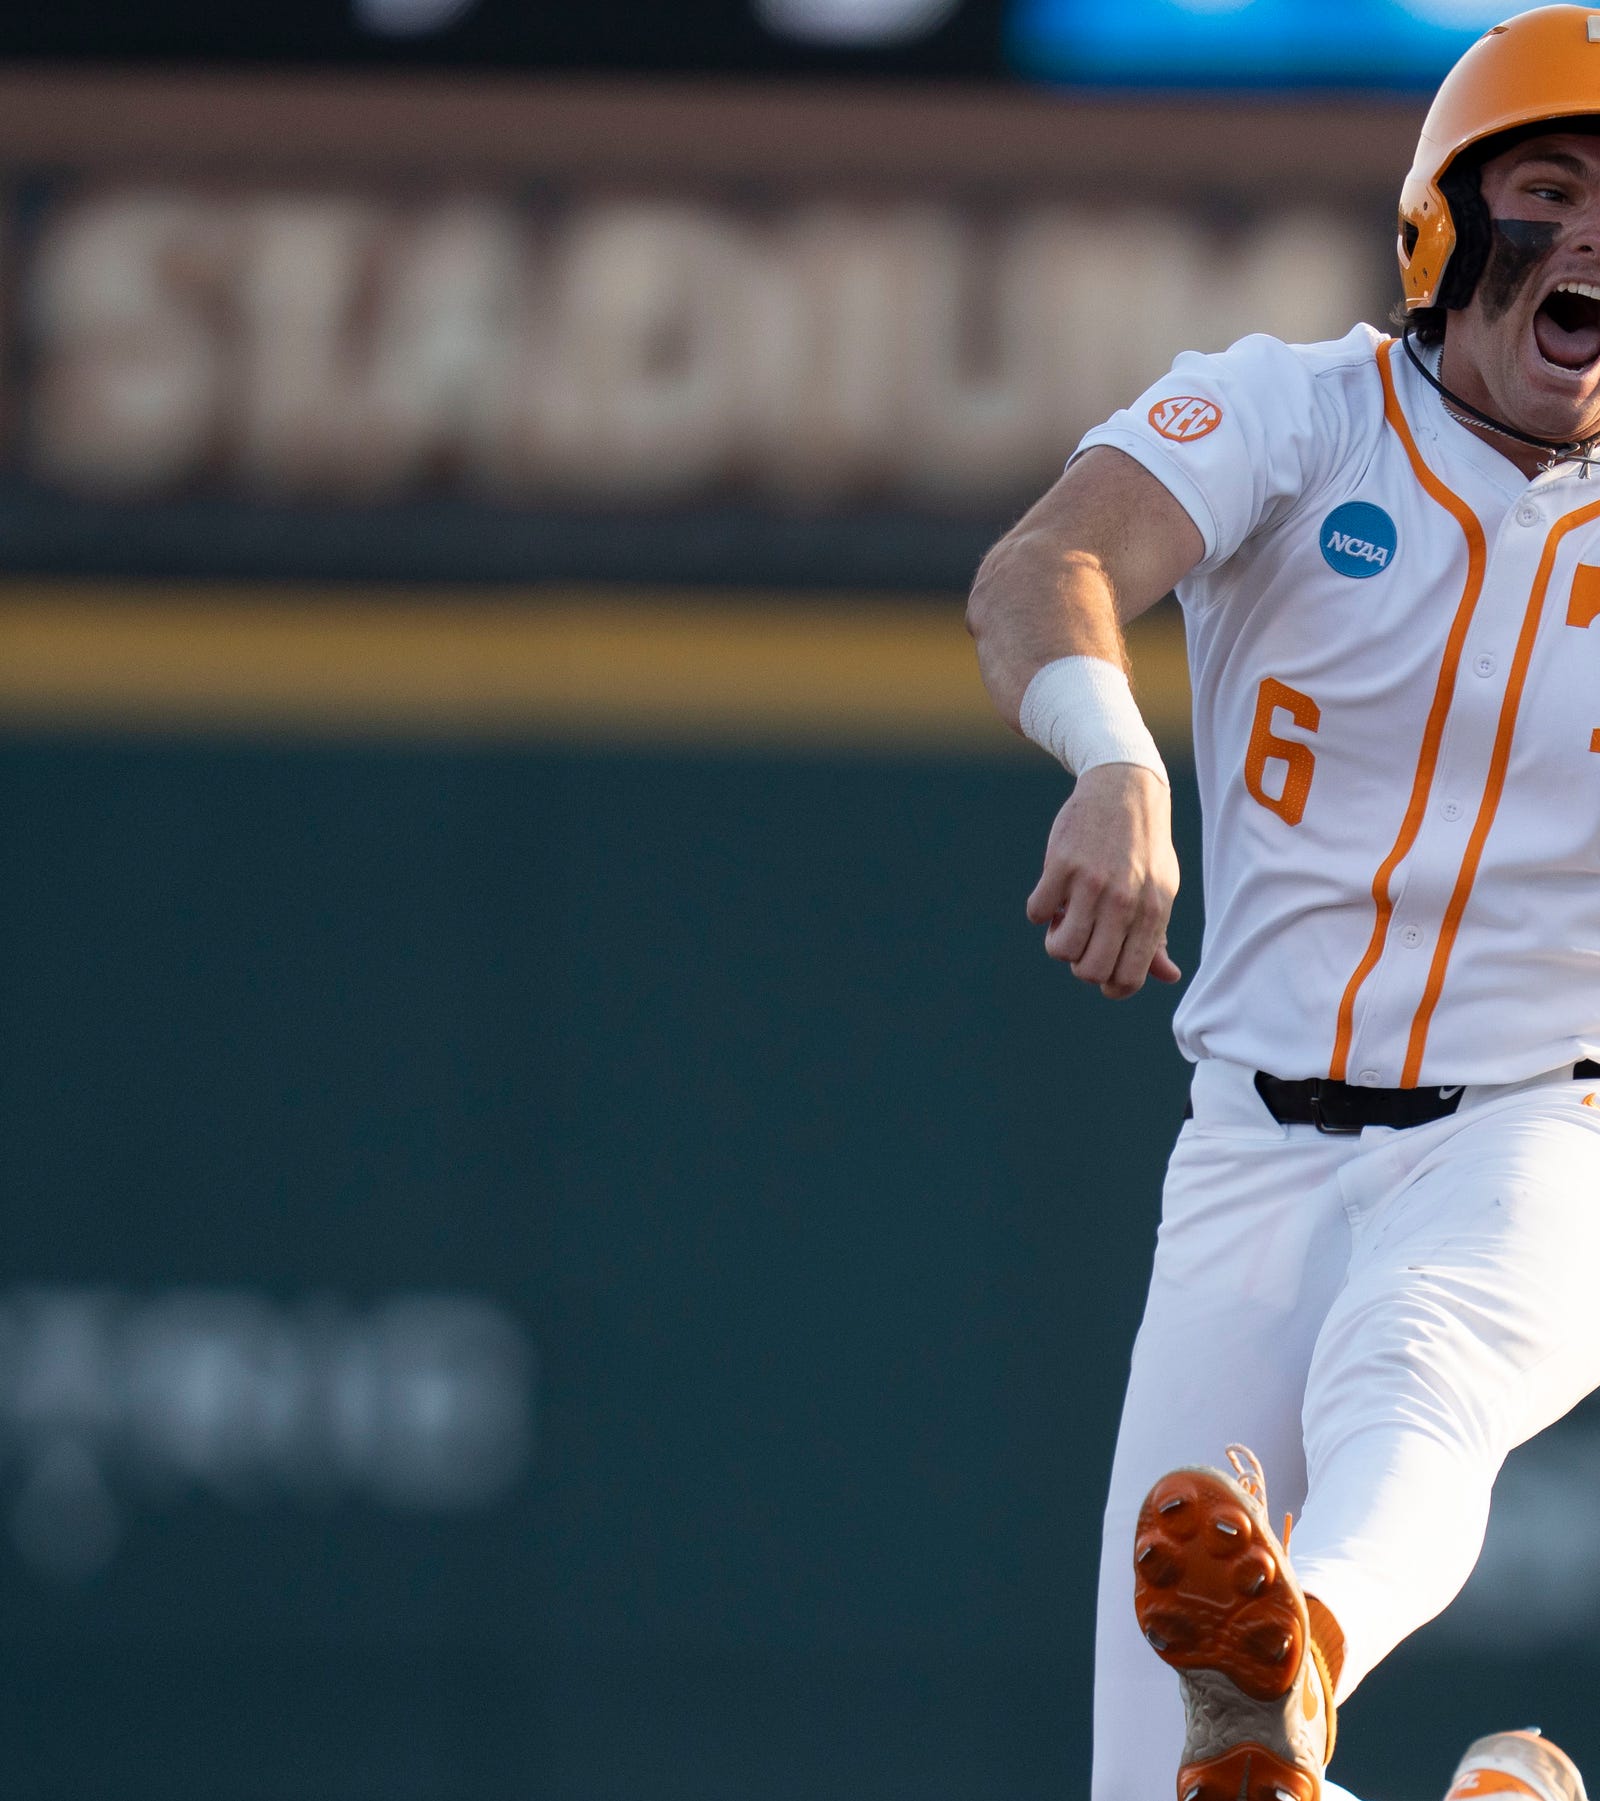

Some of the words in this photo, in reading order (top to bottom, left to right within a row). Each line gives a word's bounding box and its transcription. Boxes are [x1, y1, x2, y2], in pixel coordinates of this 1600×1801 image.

[33, 192, 1385, 508] STADIUM
[1152, 396, 1218, 438] SEC
[1326, 530, 1389, 568] NCAA
[1244, 676, 1321, 827] 6
